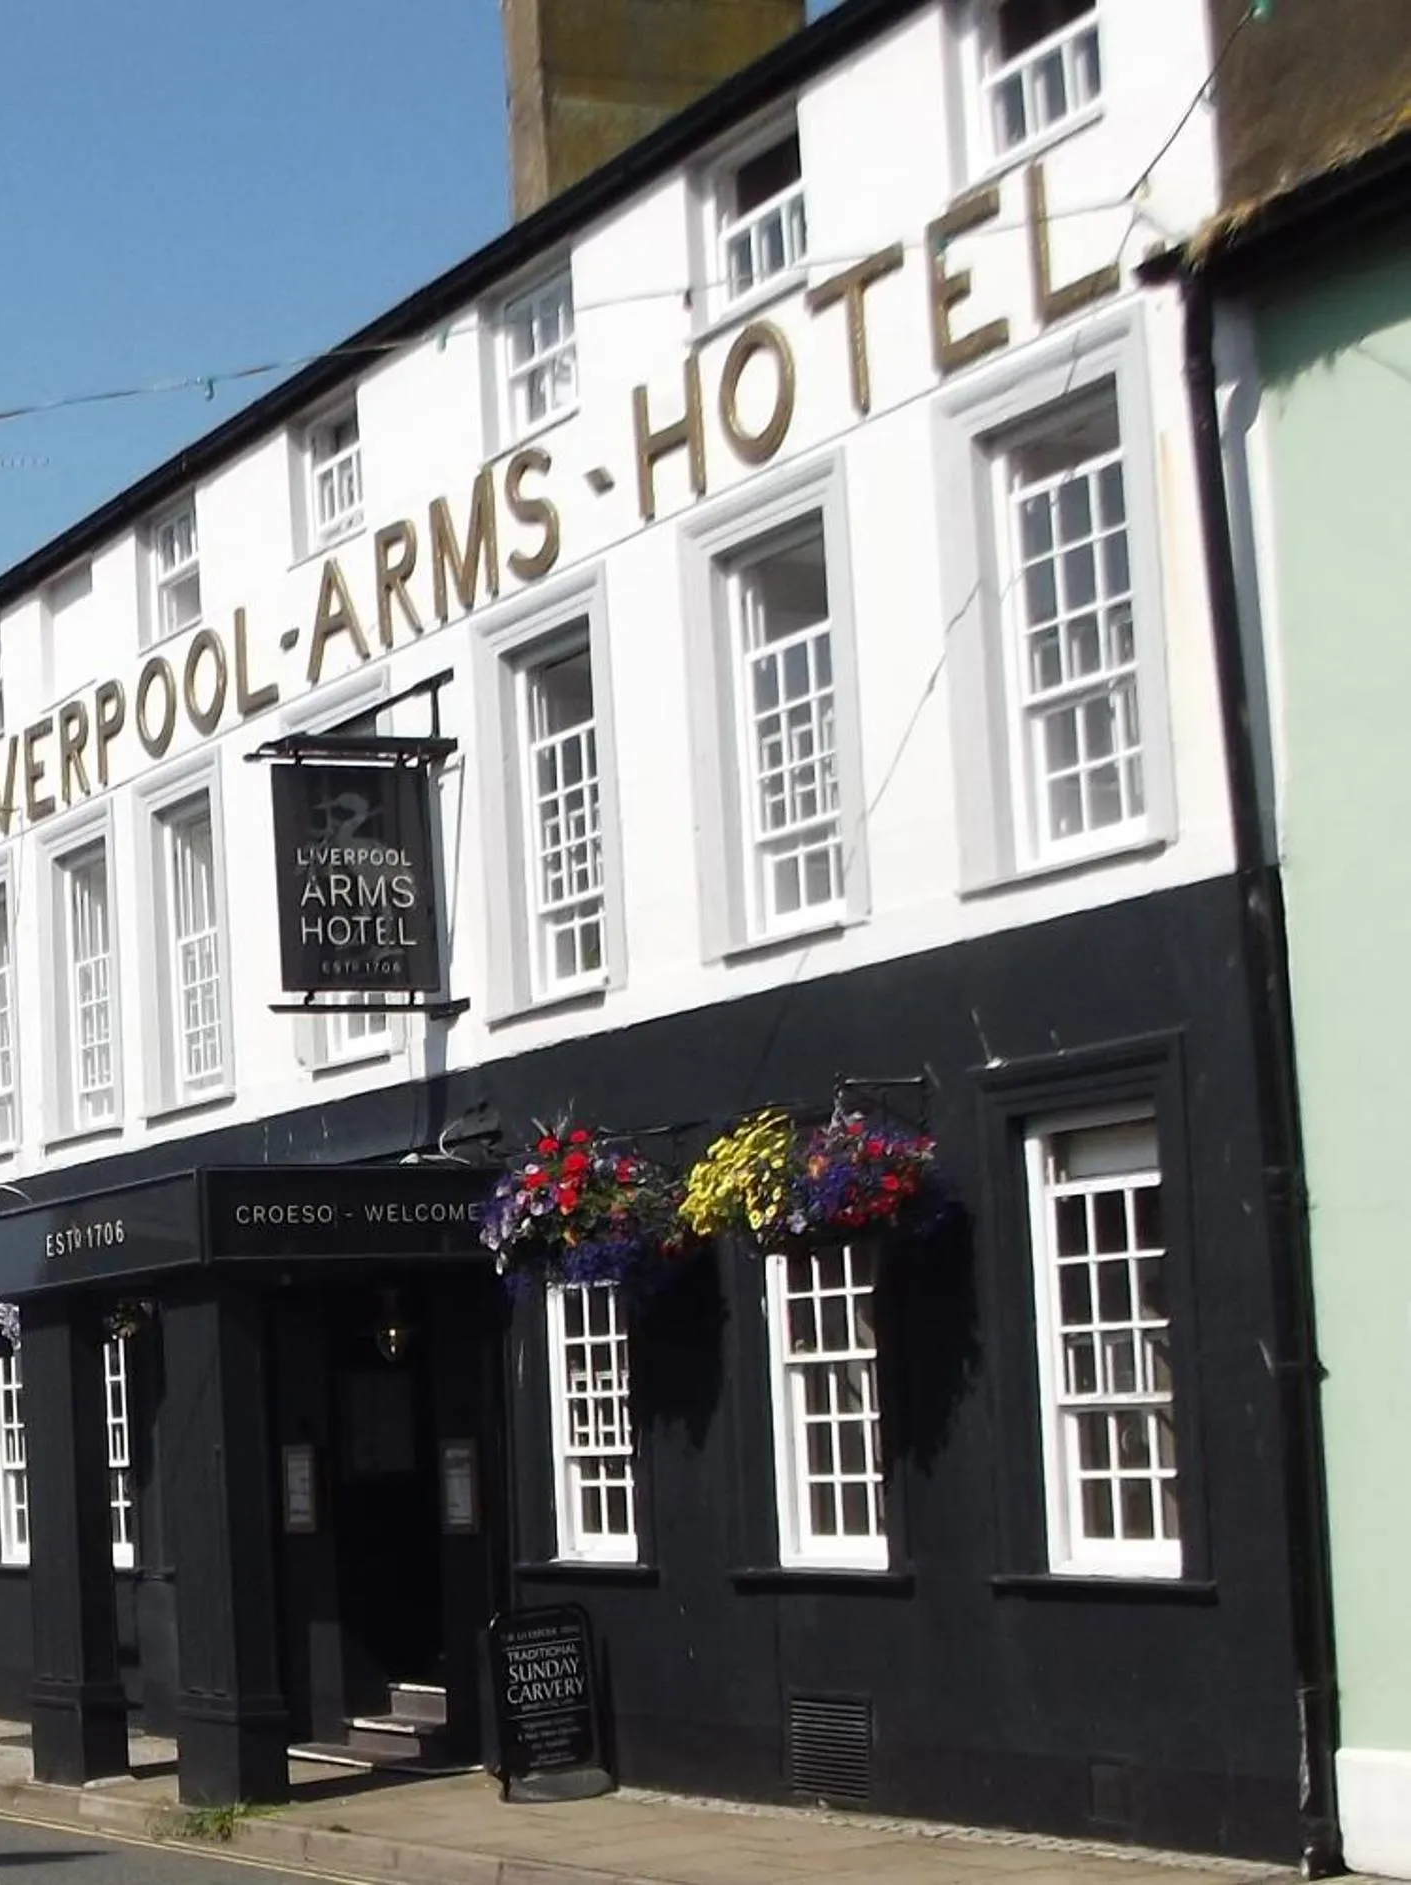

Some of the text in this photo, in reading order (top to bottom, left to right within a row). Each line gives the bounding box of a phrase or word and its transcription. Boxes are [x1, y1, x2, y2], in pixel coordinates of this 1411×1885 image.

[306, 448, 561, 684] ARMS
[632, 160, 1121, 522] HOTEL
[297, 848, 412, 866] LIVERPOOL
[301, 875, 415, 908] ARMS
[301, 916, 417, 945] HOTEL
[236, 1205, 332, 1224] CROESO
[365, 1203, 480, 1221] WELCOME
[87, 1219, 124, 1248] 1706
[507, 1644, 578, 1663] TRADITIONAL
[509, 1656, 579, 1684] SUNDAY
[507, 1675, 584, 1704] CARVERY
